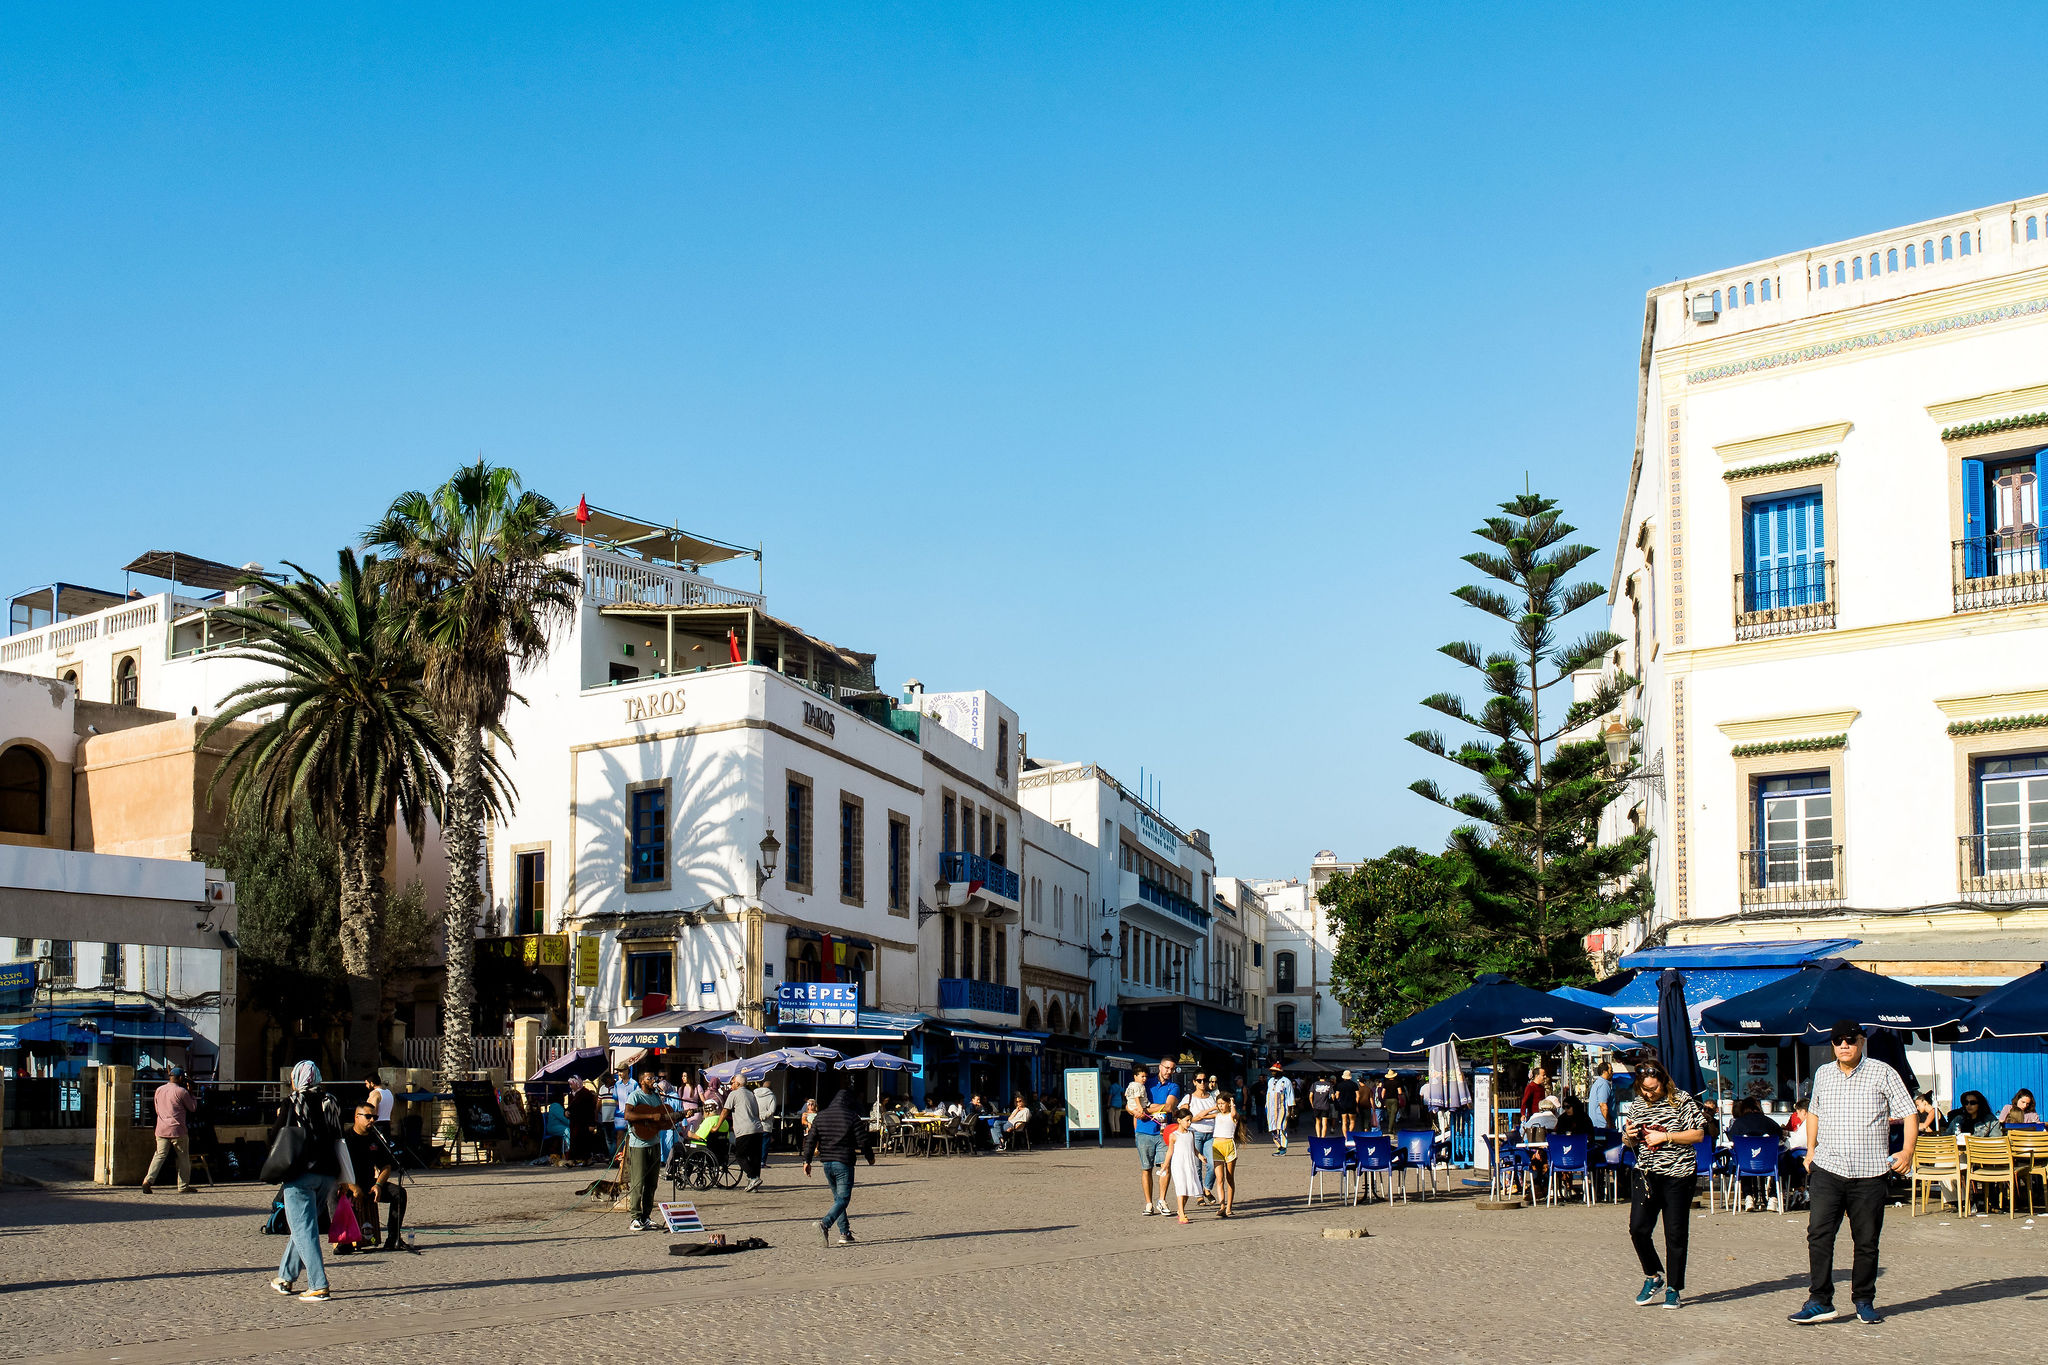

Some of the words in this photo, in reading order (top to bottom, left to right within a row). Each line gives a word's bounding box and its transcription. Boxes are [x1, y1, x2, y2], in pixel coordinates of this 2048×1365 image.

[623, 688, 686, 721] TAROS
[802, 700, 836, 736] TAROS
[971, 696, 980, 747] RASTA
[780, 985, 856, 1000] CRÊPES
[608, 1034, 634, 1046] Unique
[635, 1035, 659, 1044] VIBES
